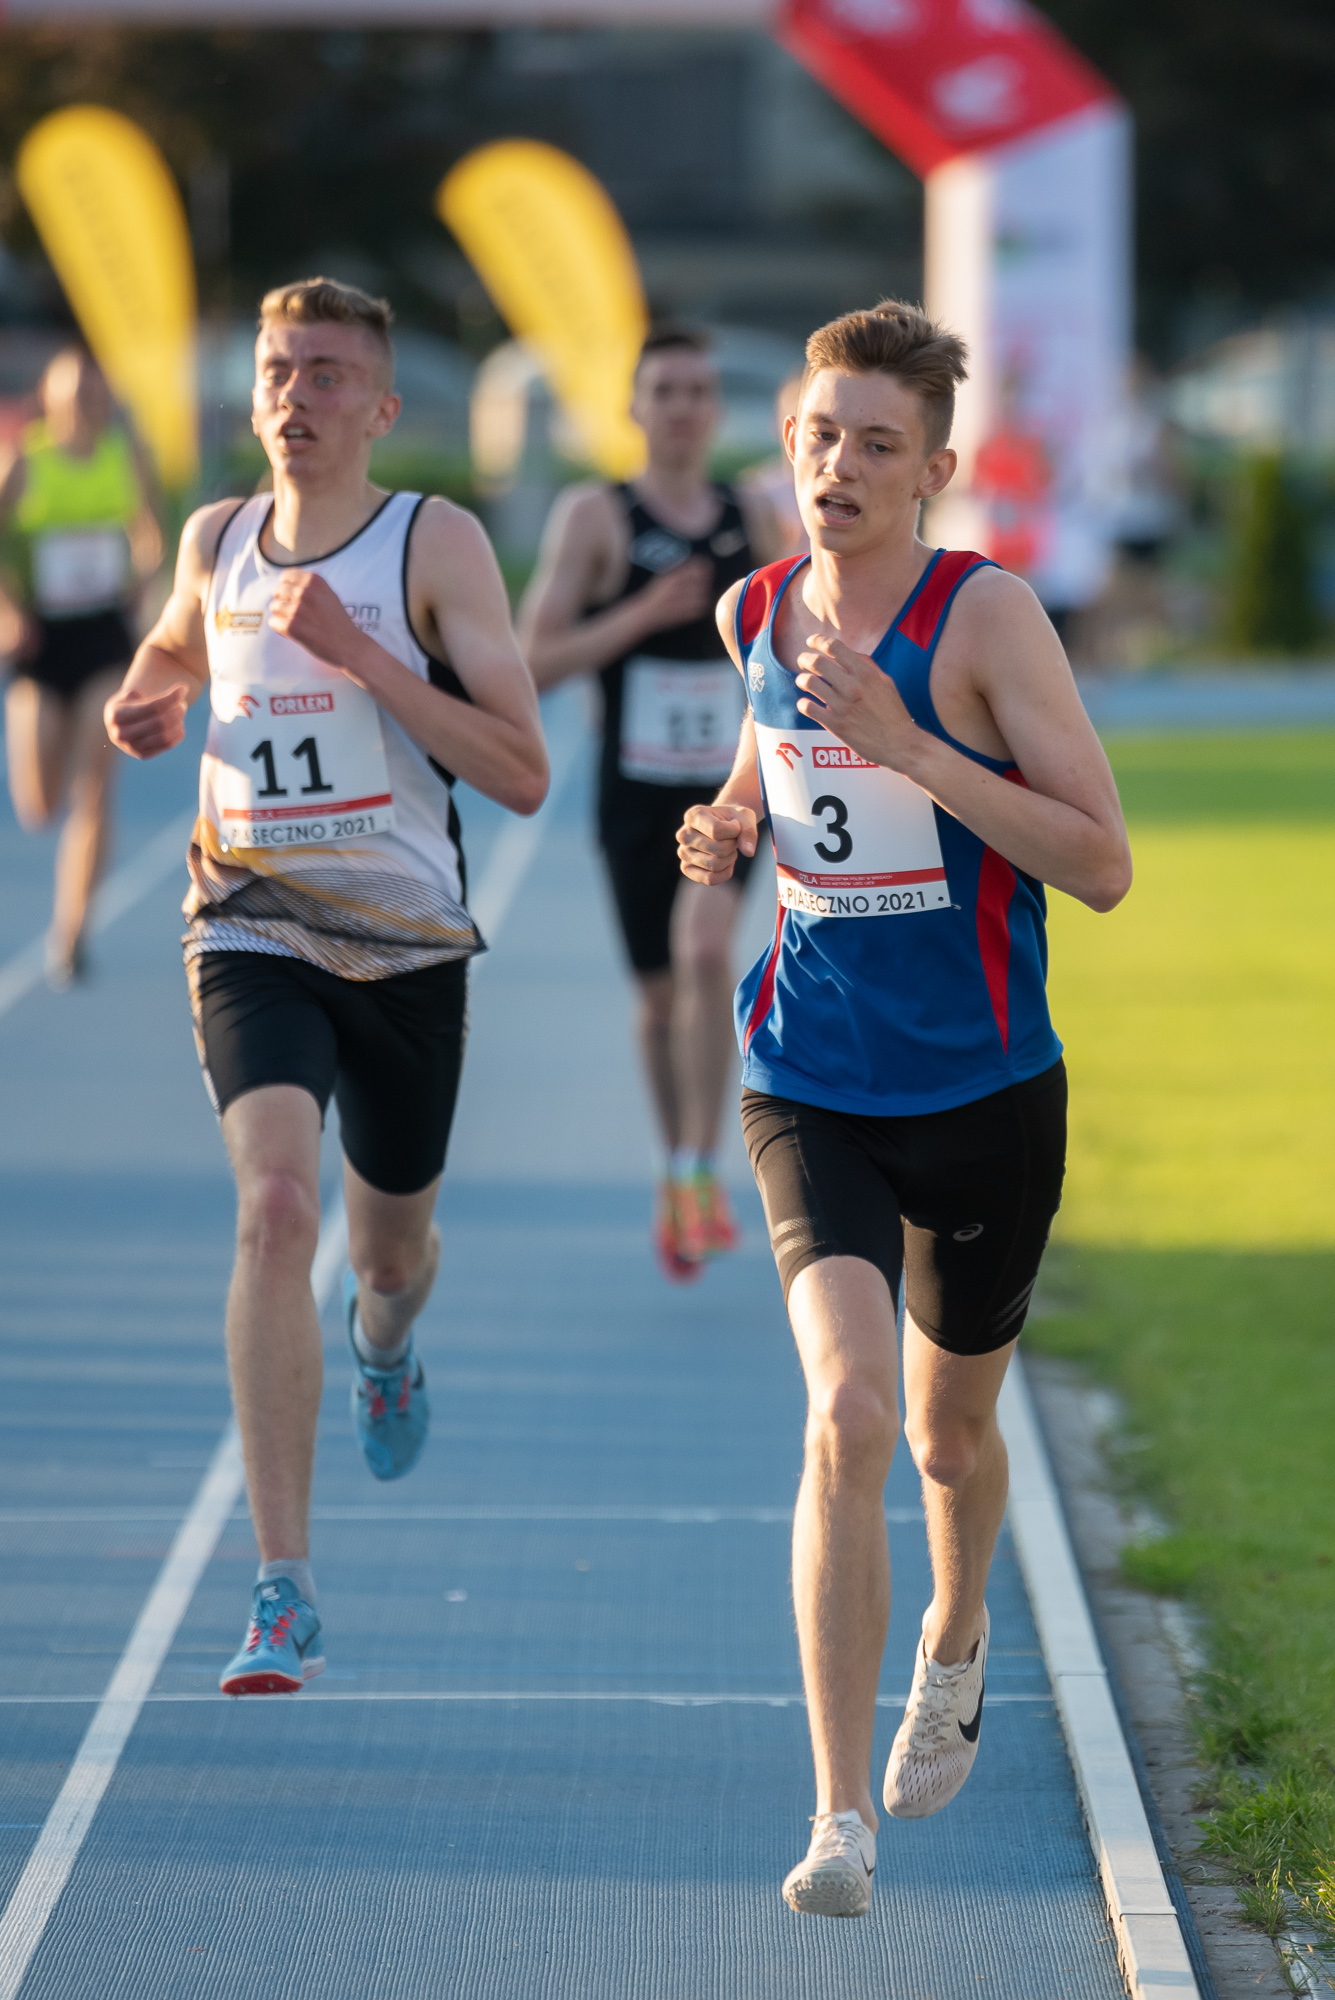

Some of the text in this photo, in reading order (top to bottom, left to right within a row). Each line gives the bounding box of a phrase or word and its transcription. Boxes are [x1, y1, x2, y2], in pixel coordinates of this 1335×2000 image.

[273, 696, 329, 714] ORLEN
[250, 737, 333, 797] 11
[815, 749, 877, 766] ORLE
[232, 816, 376, 845] PASECZNO 2021
[811, 795, 854, 864] 3
[798, 873, 818, 885] PZLA
[786, 887, 926, 914] PIASECZNO 2021
